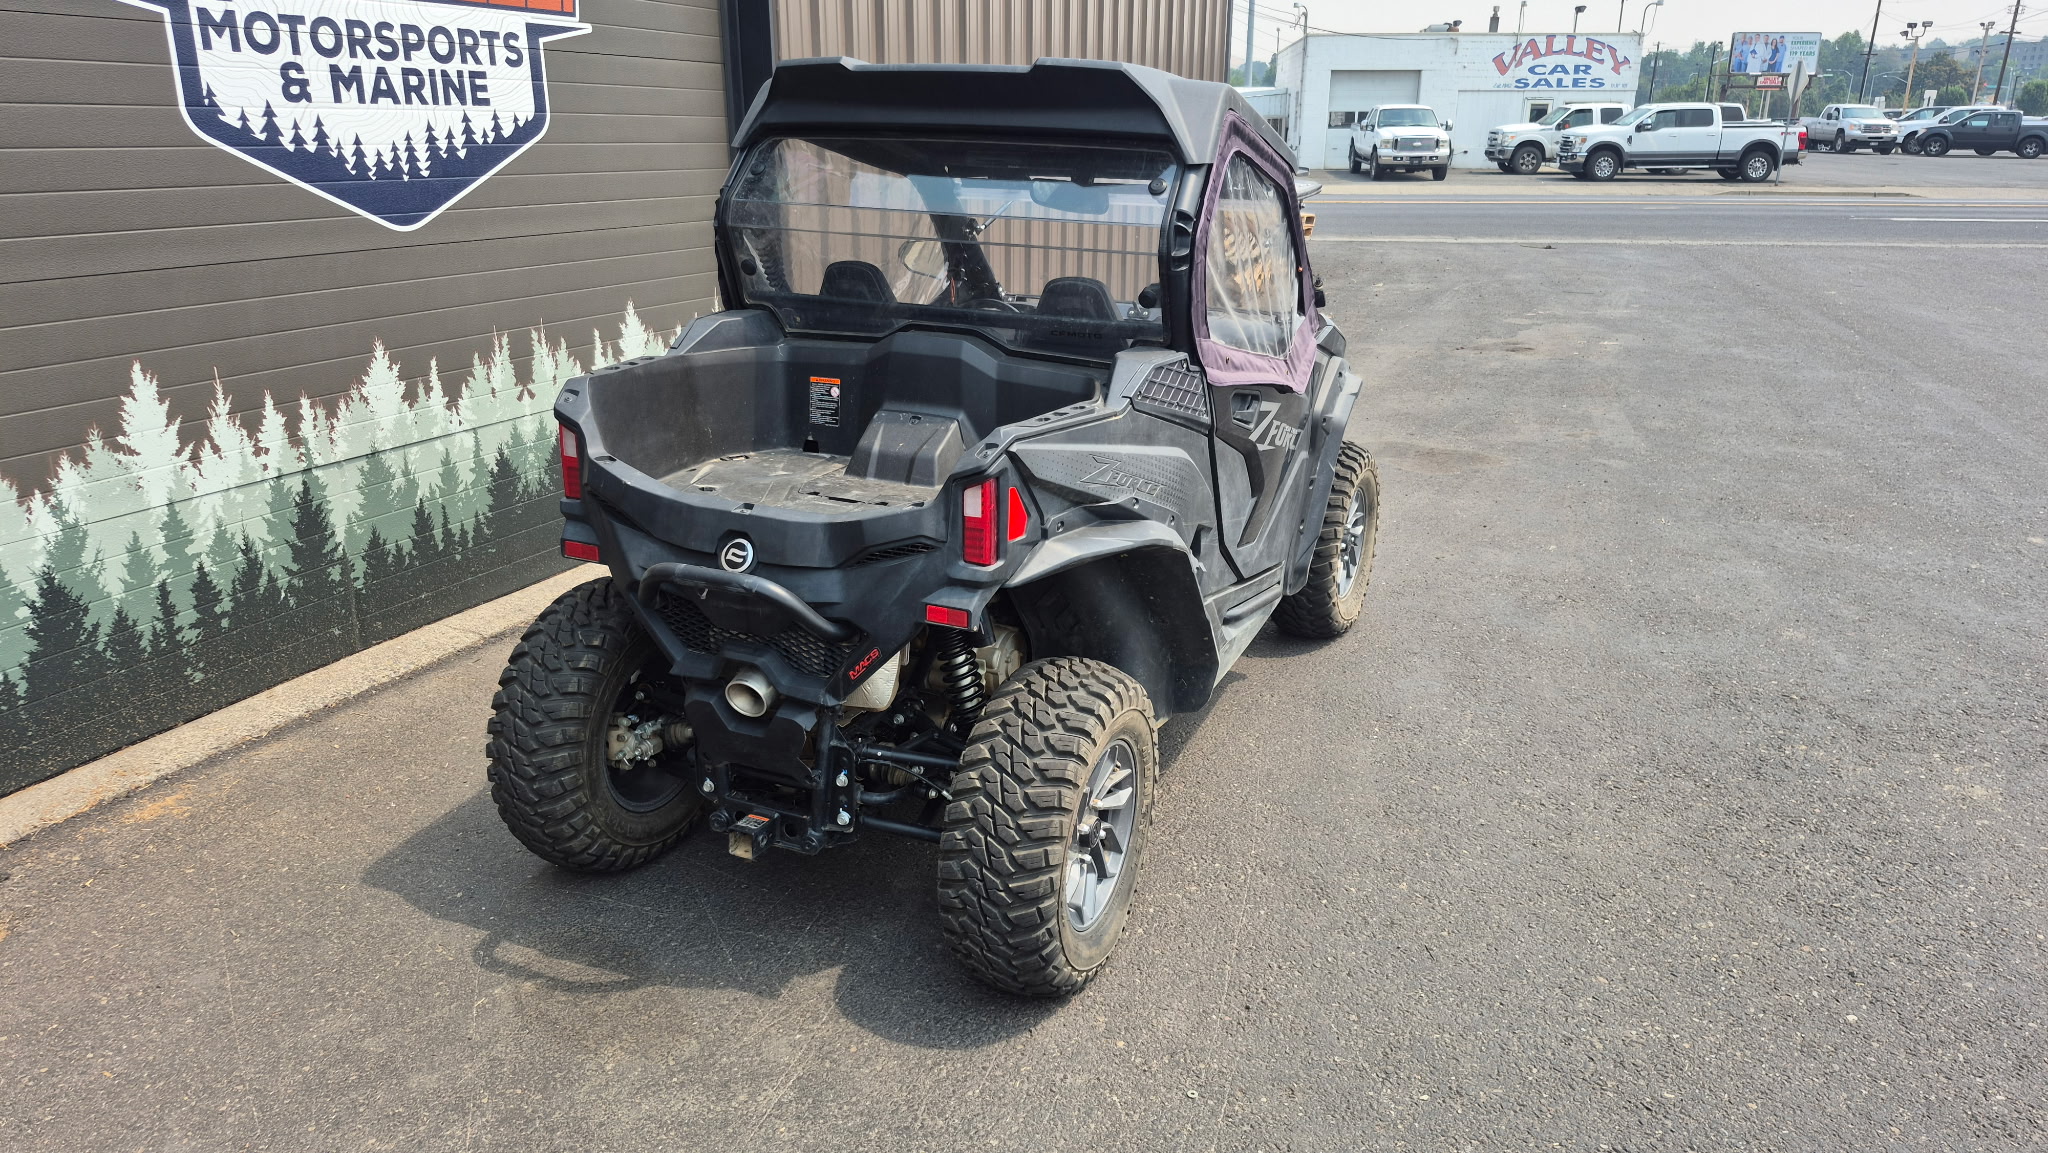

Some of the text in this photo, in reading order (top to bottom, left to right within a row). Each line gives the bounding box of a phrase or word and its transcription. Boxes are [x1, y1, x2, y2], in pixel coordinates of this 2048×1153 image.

[196, 6, 524, 69] MOTORSPORTS
[1492, 35, 1630, 76] VALLEY
[280, 61, 491, 107] & MARINE
[1514, 77, 1605, 89] SALES
[1528, 64, 1592, 75] CAR
[848, 648, 879, 680] MACS
